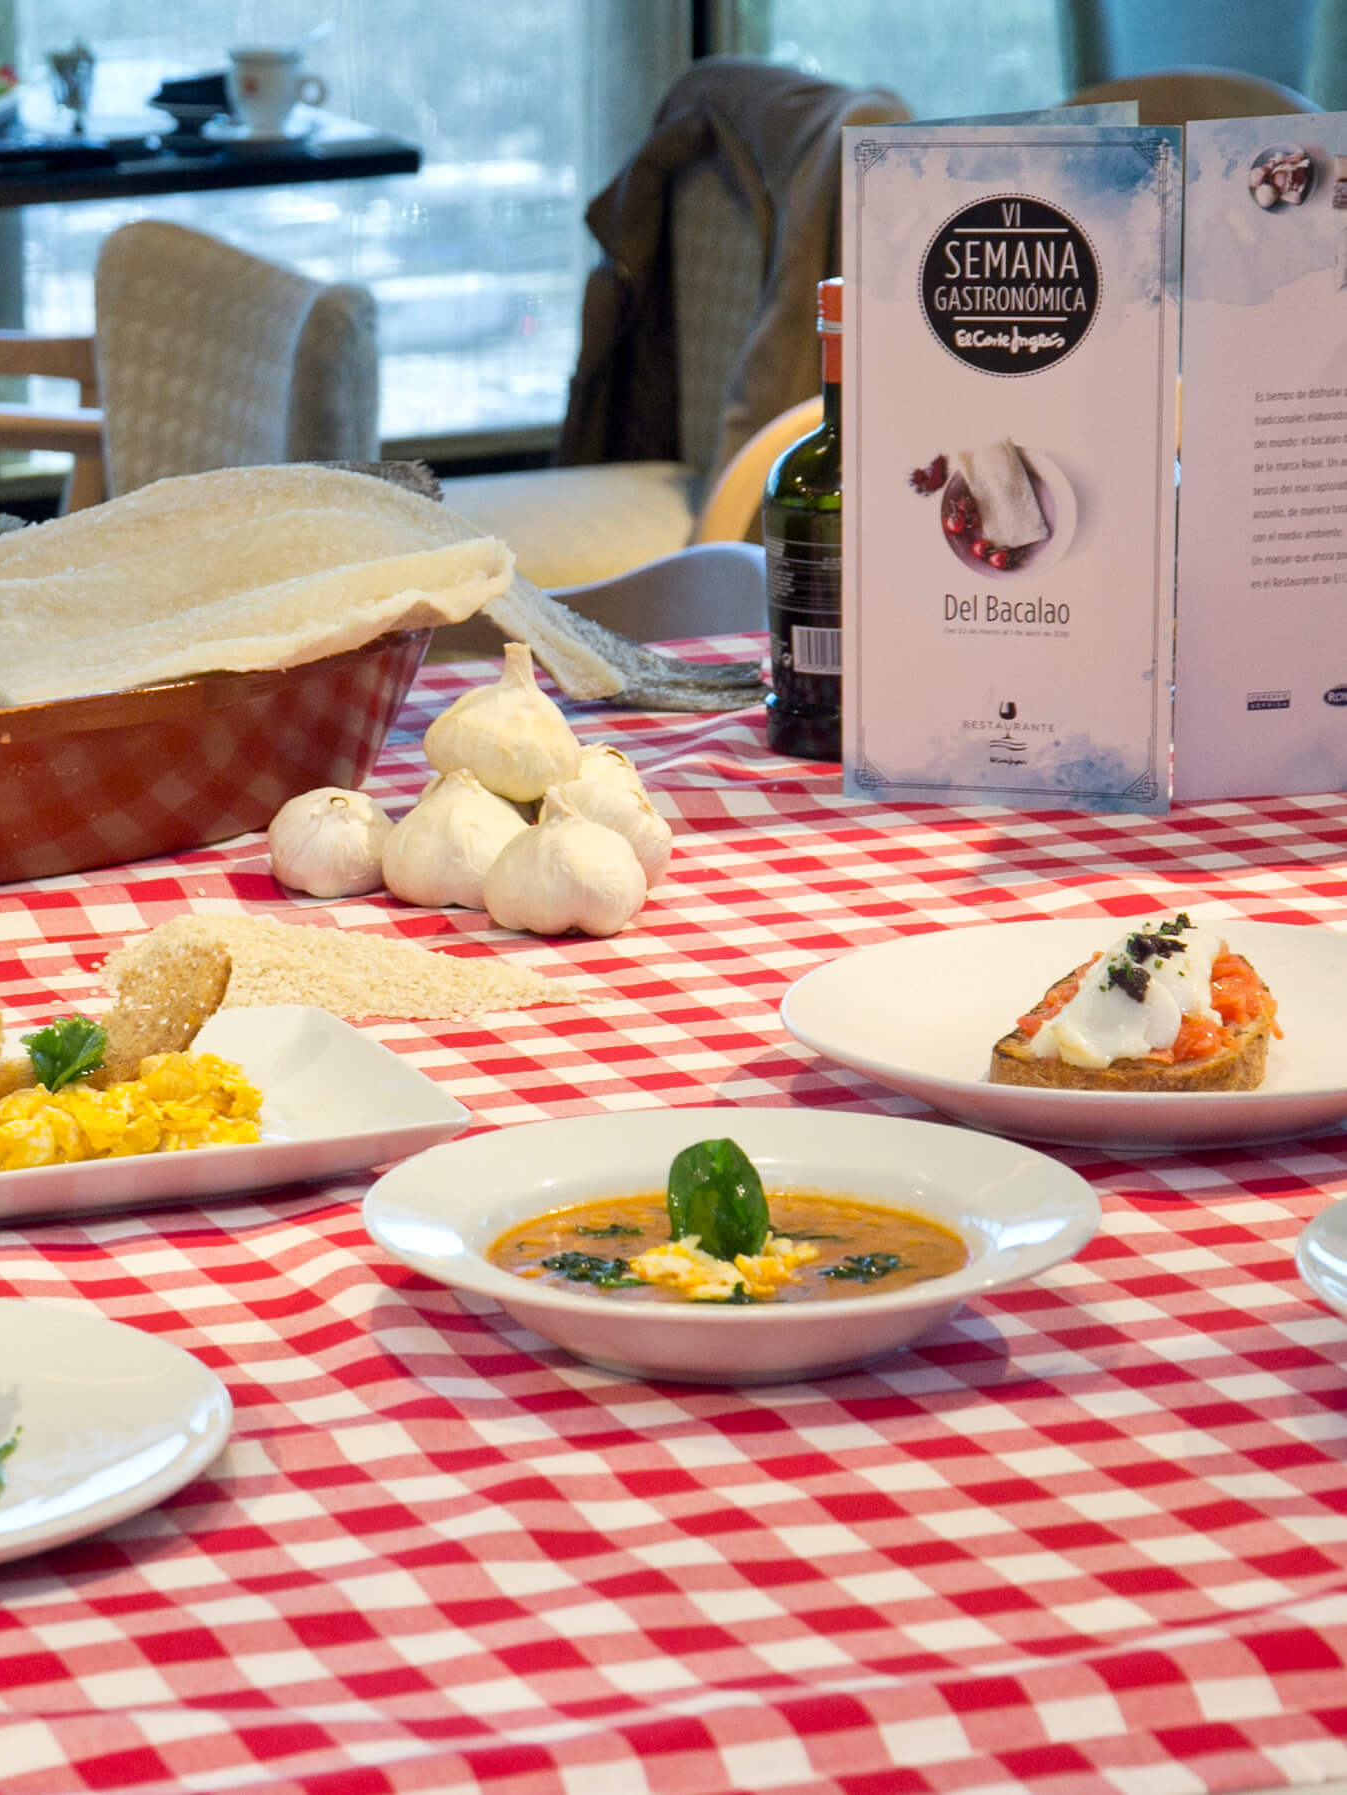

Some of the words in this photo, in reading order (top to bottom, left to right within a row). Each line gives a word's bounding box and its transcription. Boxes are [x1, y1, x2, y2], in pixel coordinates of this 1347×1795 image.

[1002, 203, 1021, 227] VI
[944, 240, 1079, 280] SEMANA
[934, 282, 1087, 312] GASTRONÓMICA
[973, 330, 1010, 347] Corte
[1009, 326, 1066, 354] Inglés
[944, 593, 978, 622] Del
[986, 594, 1070, 625] Bacalao
[962, 720, 1055, 733] RESTAURANTE
